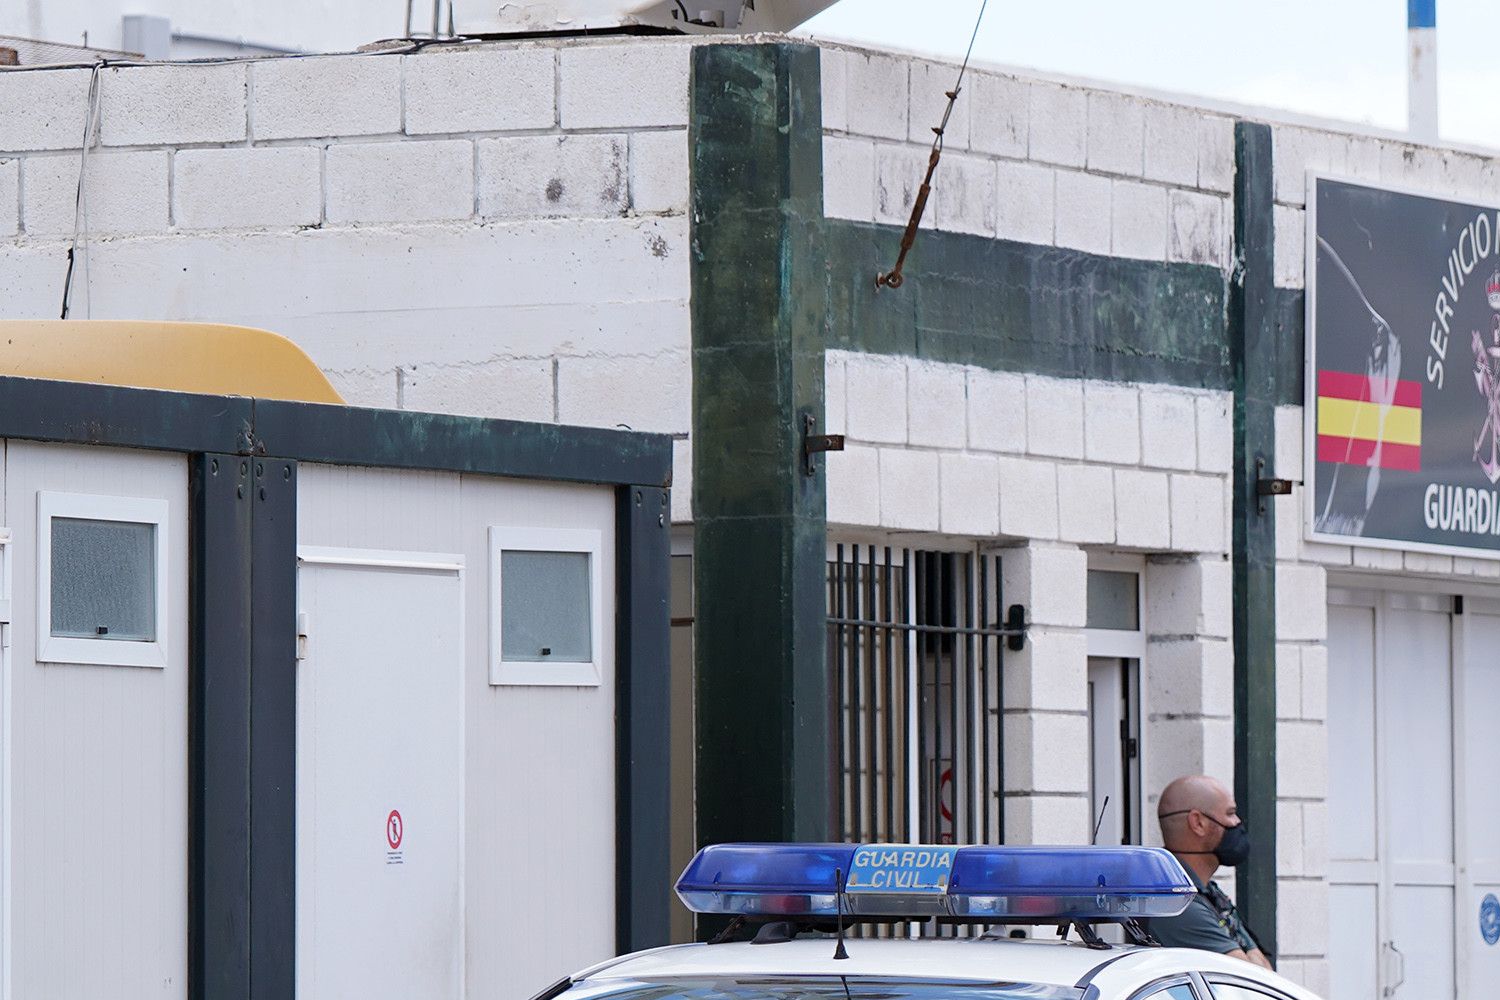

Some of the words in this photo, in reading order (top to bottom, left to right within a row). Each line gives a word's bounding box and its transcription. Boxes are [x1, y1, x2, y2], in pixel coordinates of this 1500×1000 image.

[1426, 213, 1491, 390] SERVICIO
[854, 850, 951, 868] GUARDIA
[871, 870, 926, 888] CIVIL
